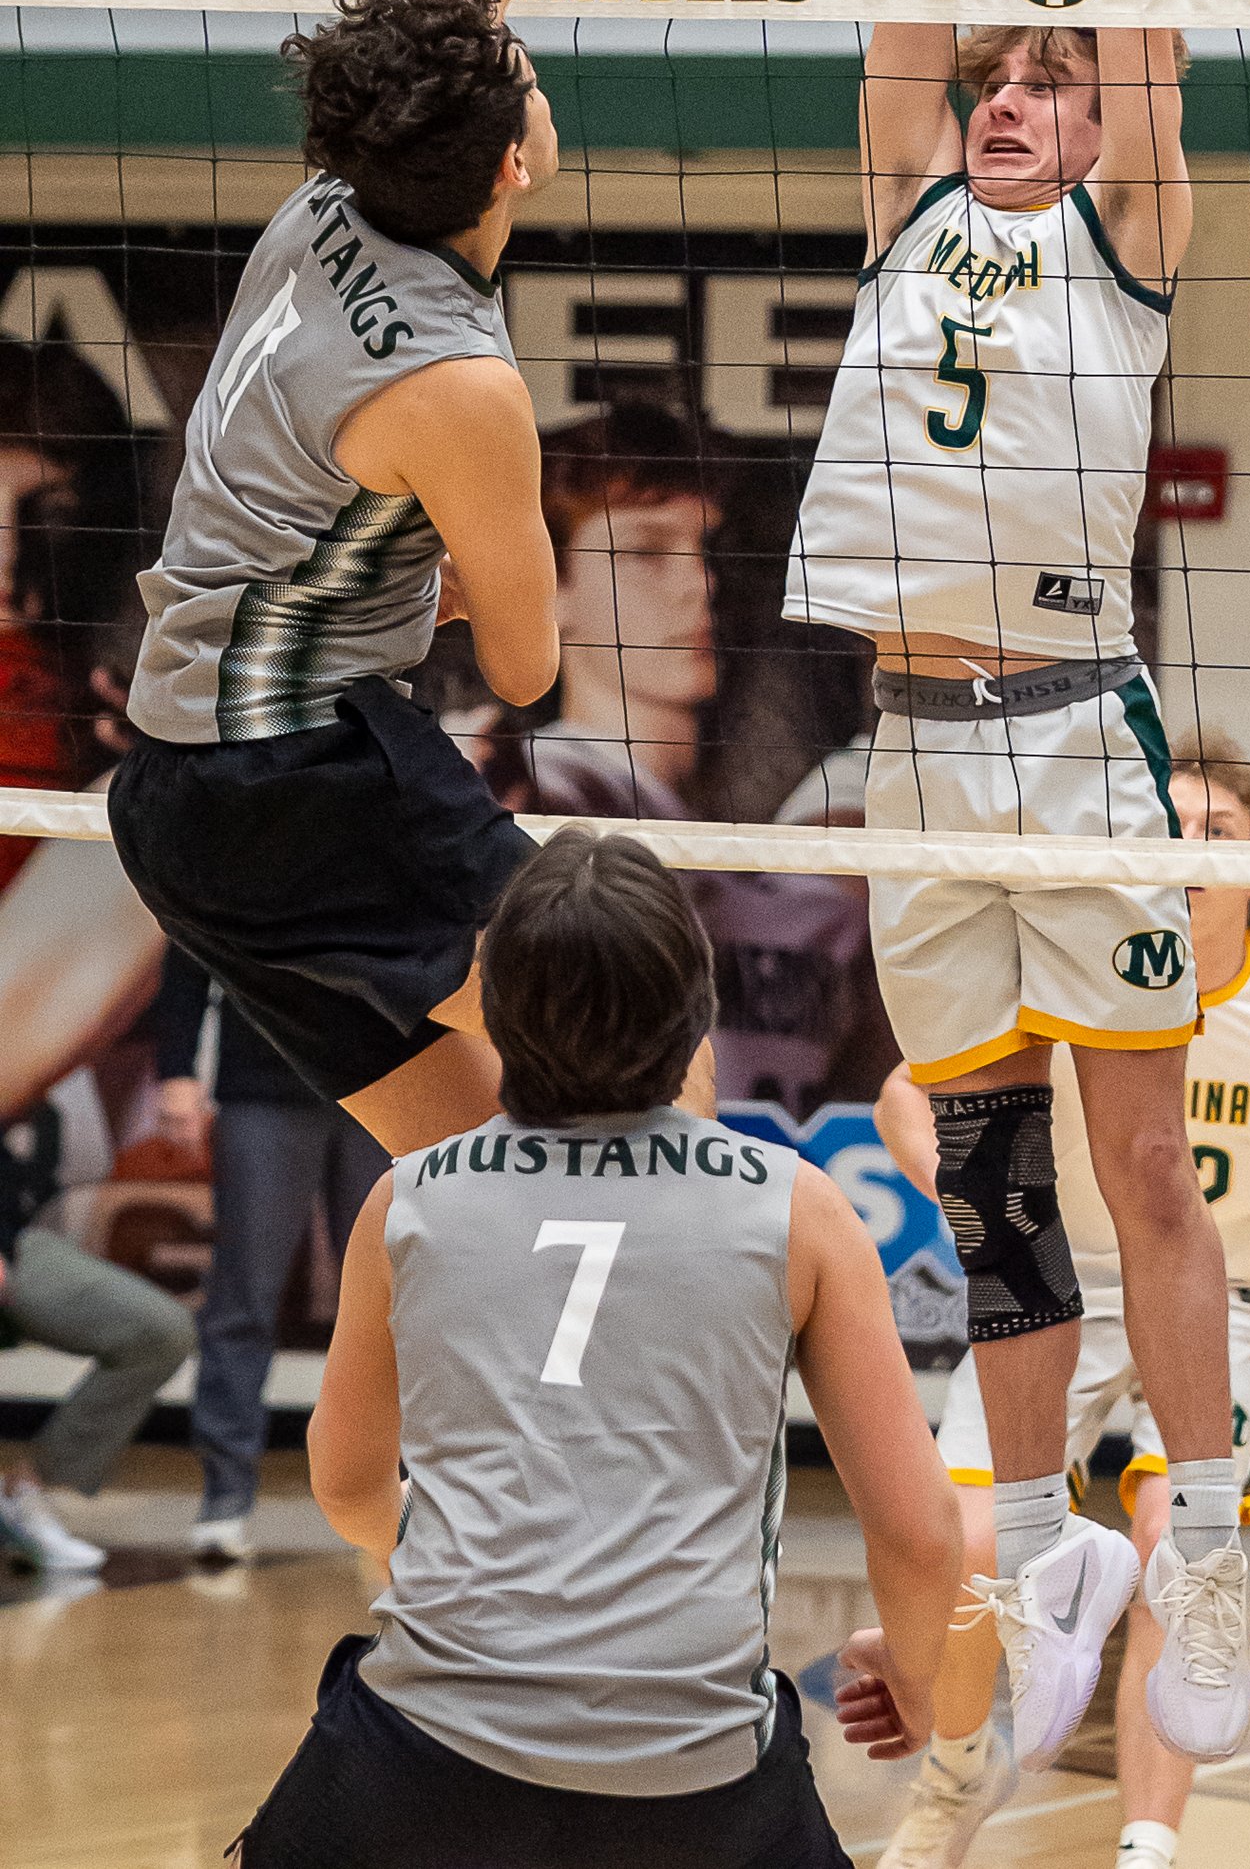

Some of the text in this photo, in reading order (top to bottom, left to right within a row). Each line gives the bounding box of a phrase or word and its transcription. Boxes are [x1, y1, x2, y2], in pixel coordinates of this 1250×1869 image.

[924, 314, 993, 452] 5
[415, 1132, 770, 1188] MUSTANGS
[532, 1219, 626, 1387] 7
